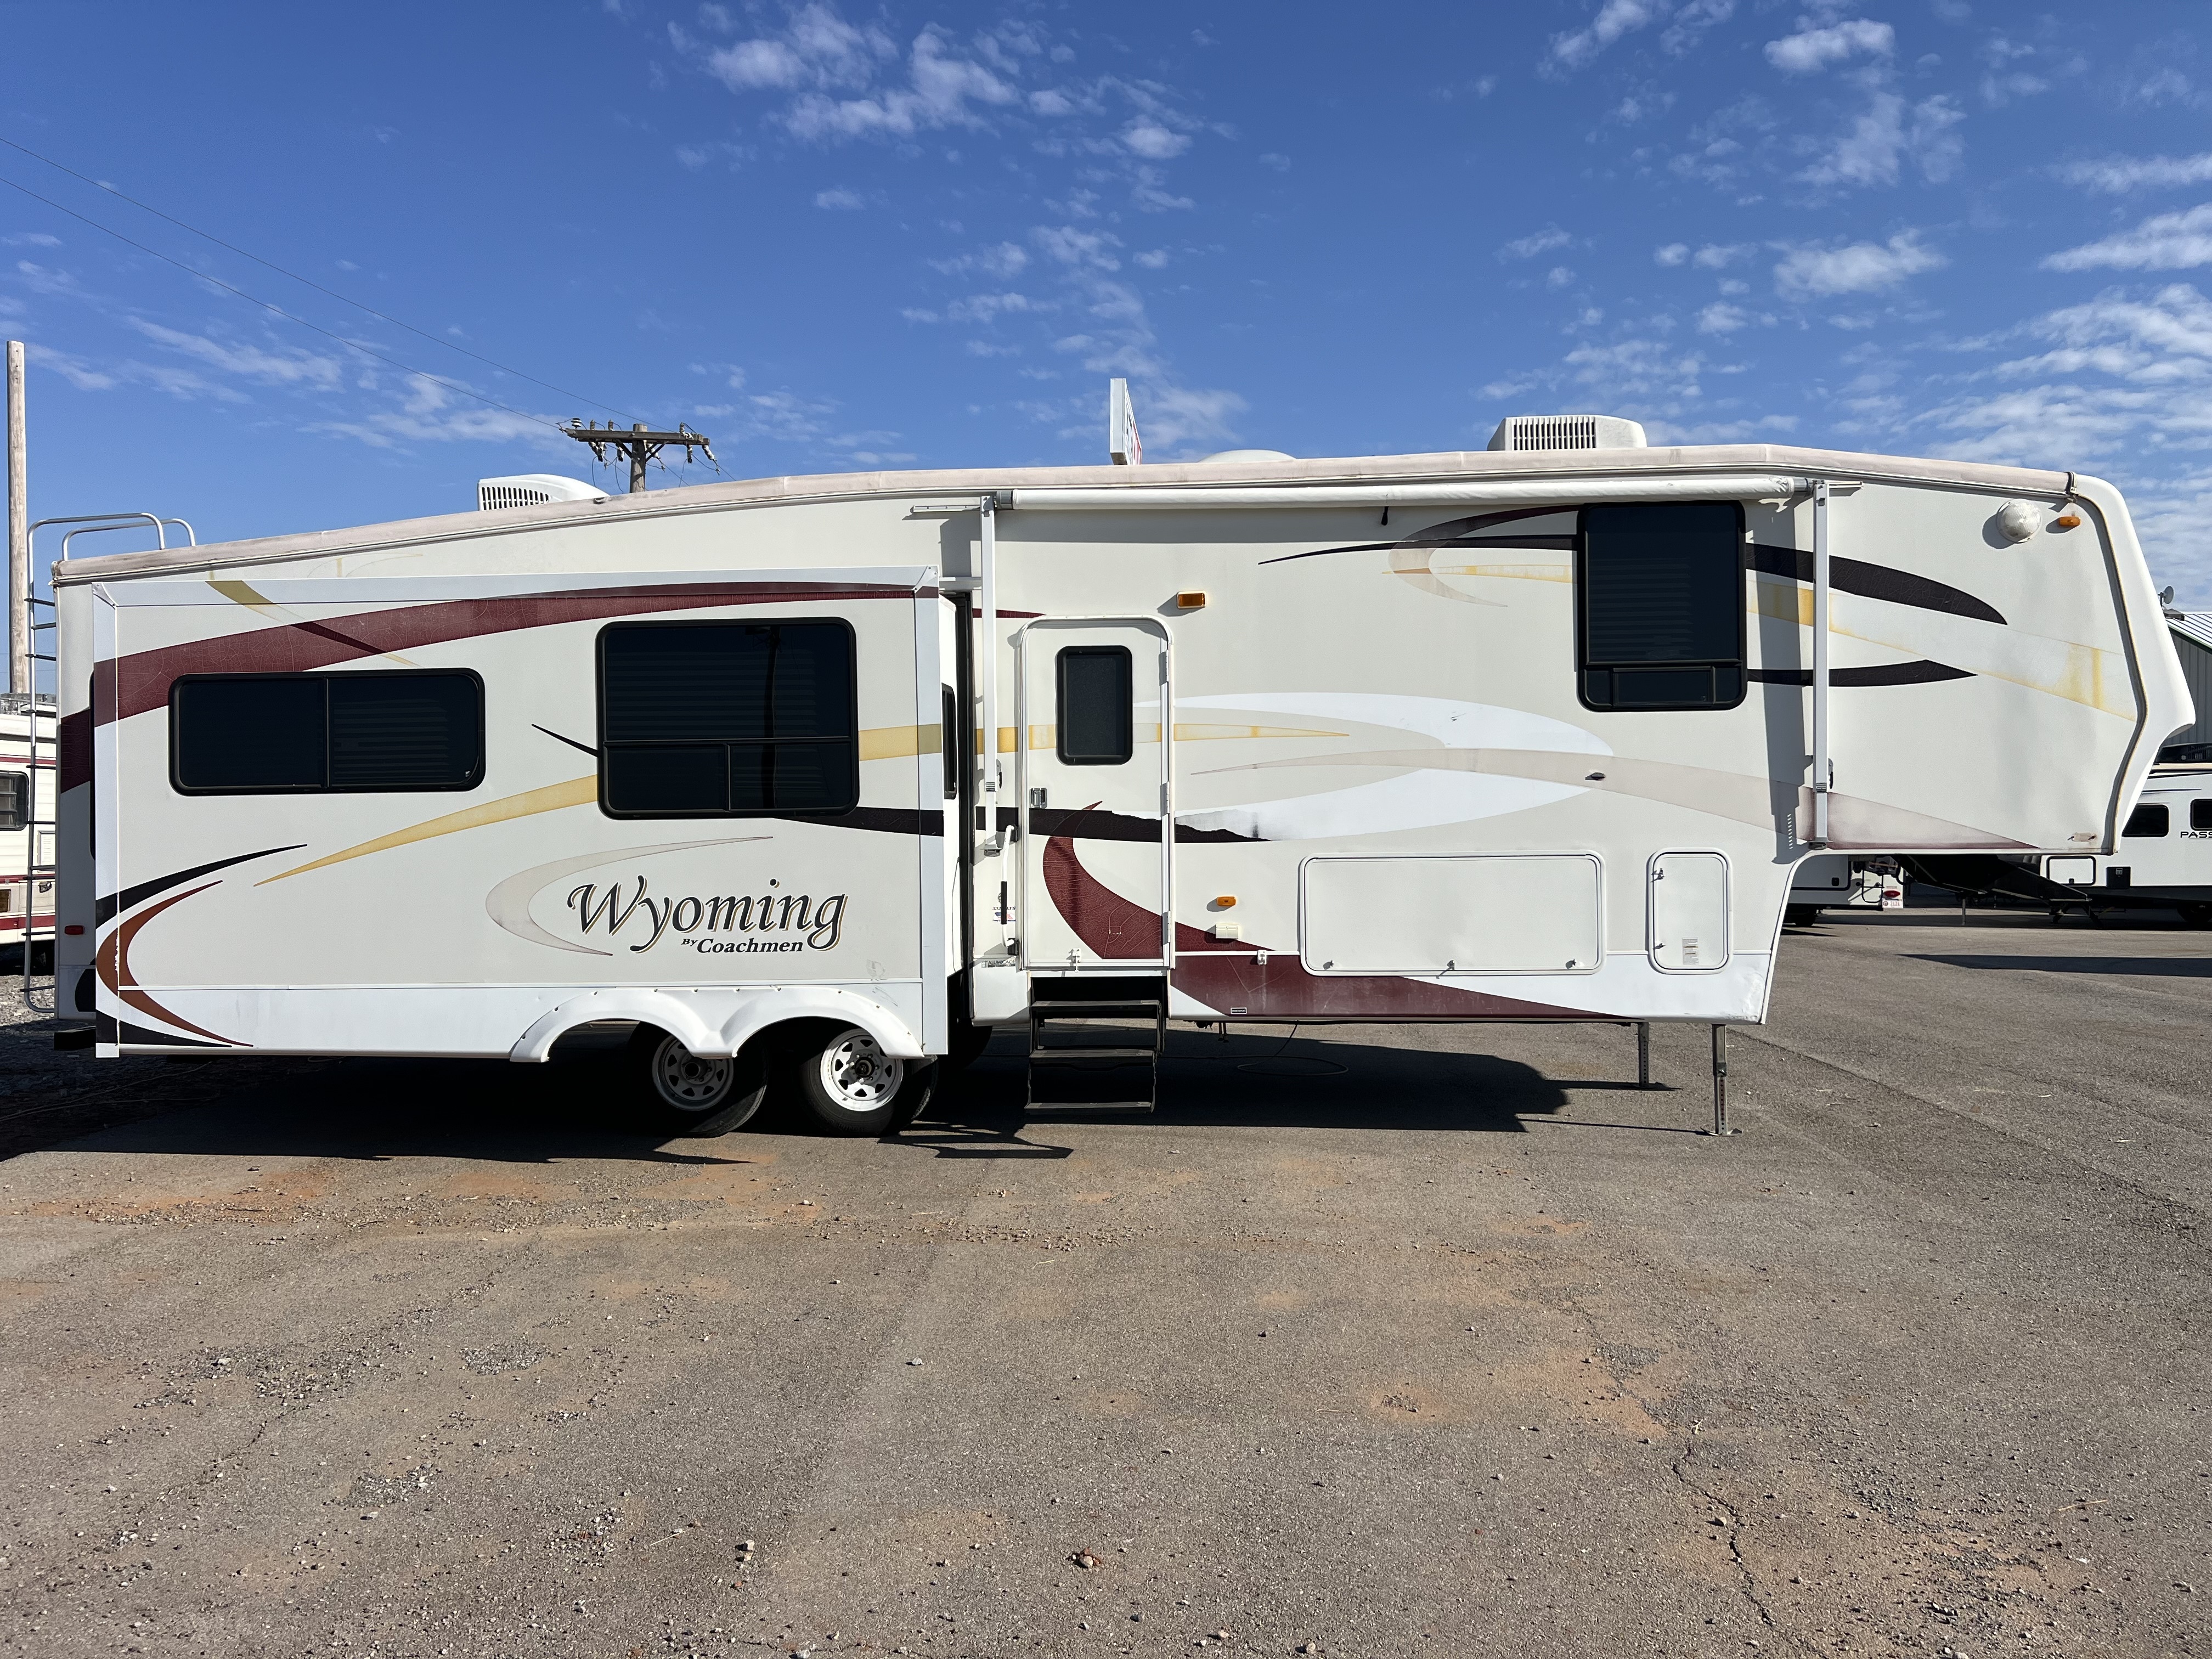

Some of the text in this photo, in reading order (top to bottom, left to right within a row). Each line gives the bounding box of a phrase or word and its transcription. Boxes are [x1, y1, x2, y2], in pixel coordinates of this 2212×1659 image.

[567, 875, 848, 953] Wyoming
[681, 938, 803, 953] By Coachmen
